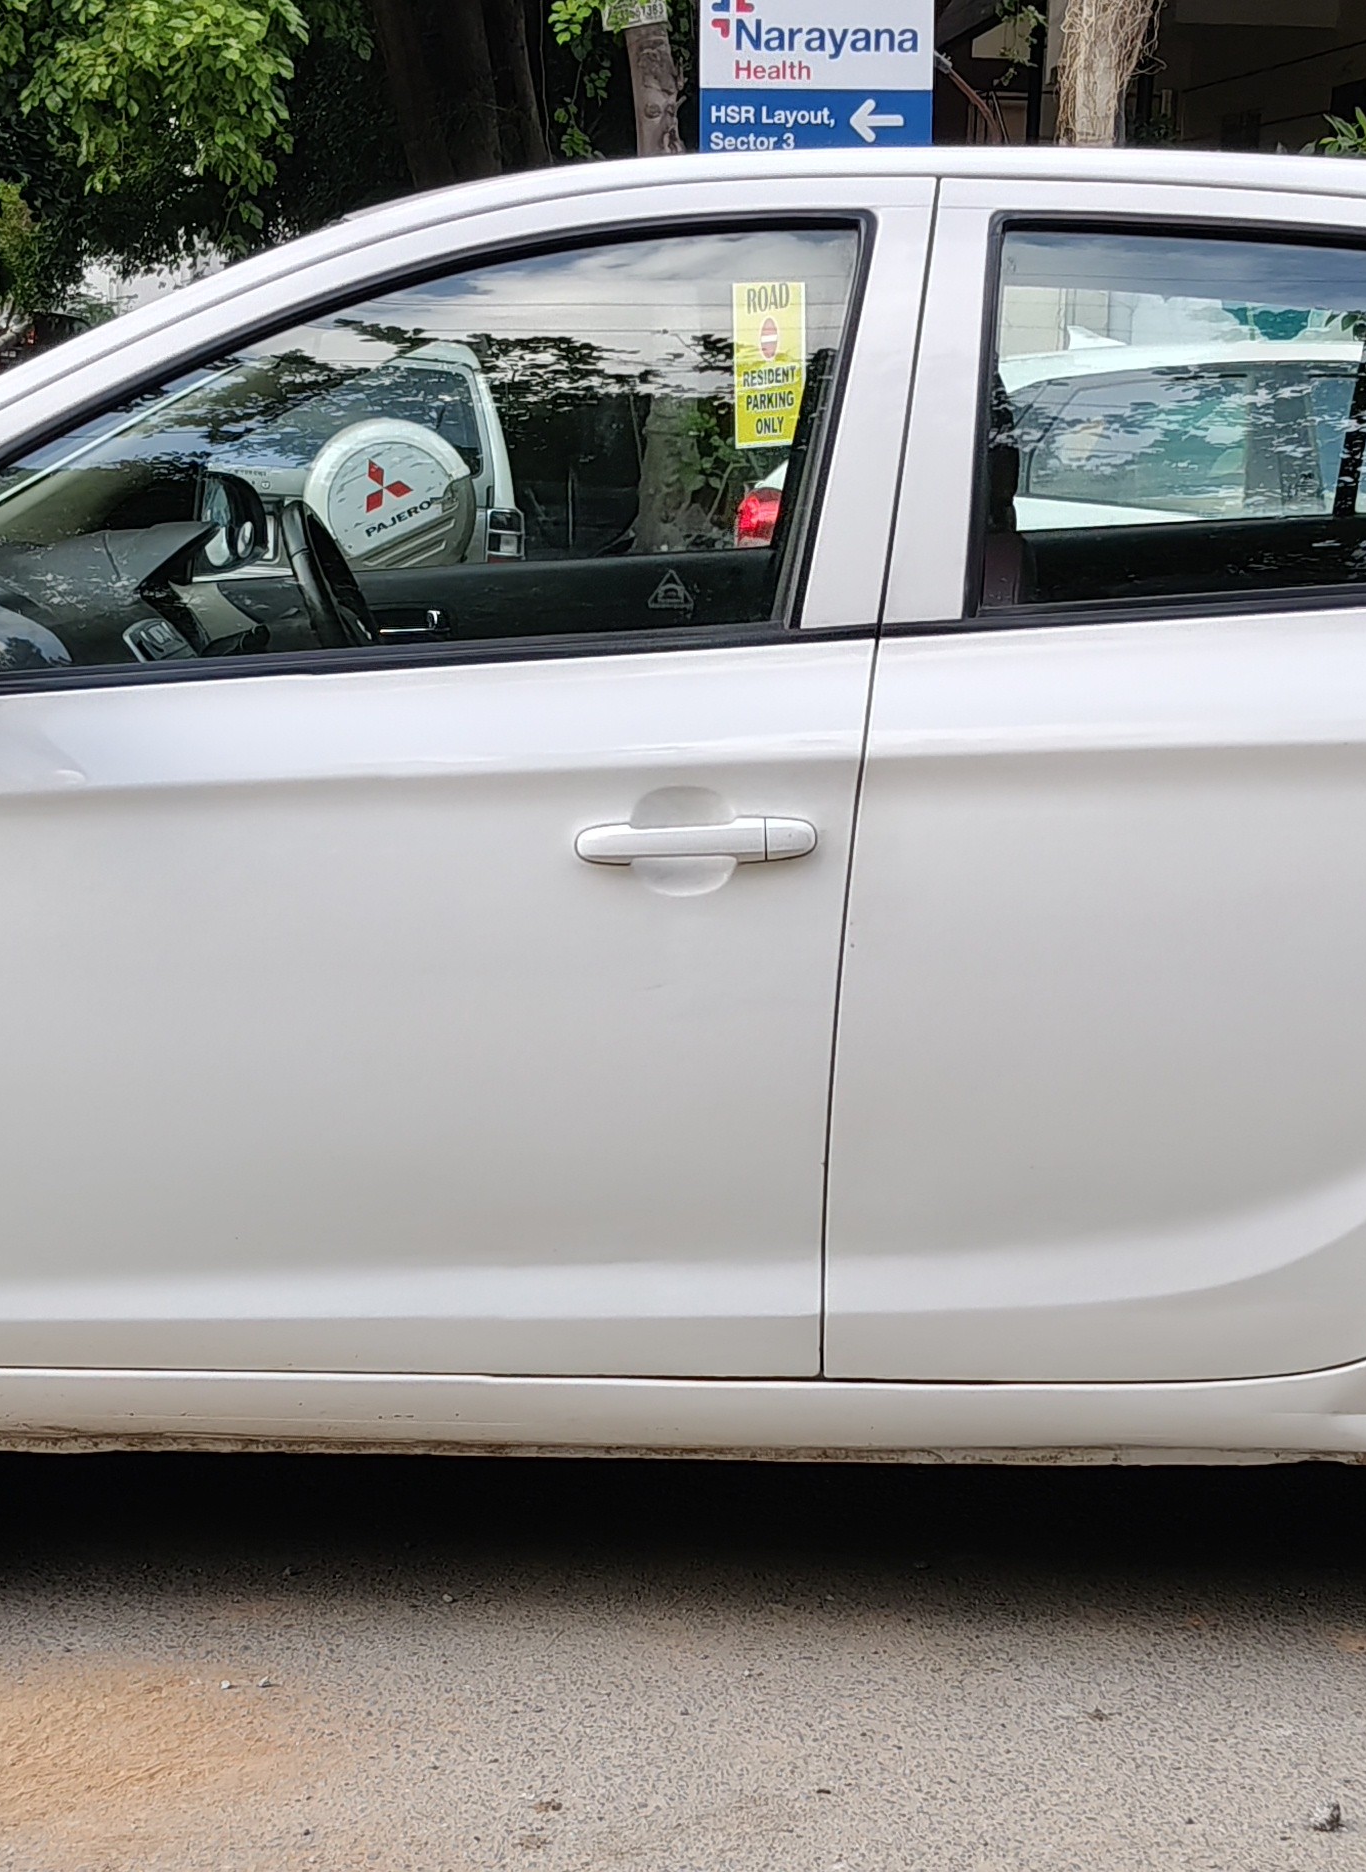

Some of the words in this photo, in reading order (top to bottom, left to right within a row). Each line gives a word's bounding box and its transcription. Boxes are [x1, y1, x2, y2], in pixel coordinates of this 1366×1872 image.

[735, 18, 919, 59] Narayana
[735, 60, 811, 80] Health
[710, 105, 755, 124] HSR
[761, 106, 835, 128] Layout,
[710, 132, 777, 150] Sector
[783, 132, 795, 150] 3
[746, 282, 790, 315] ROAD
[742, 365, 797, 387] RESIDENT
[746, 390, 795, 411] PARKING
[755, 416, 785, 435] ONLY
[366, 498, 432, 538] PAJERO
